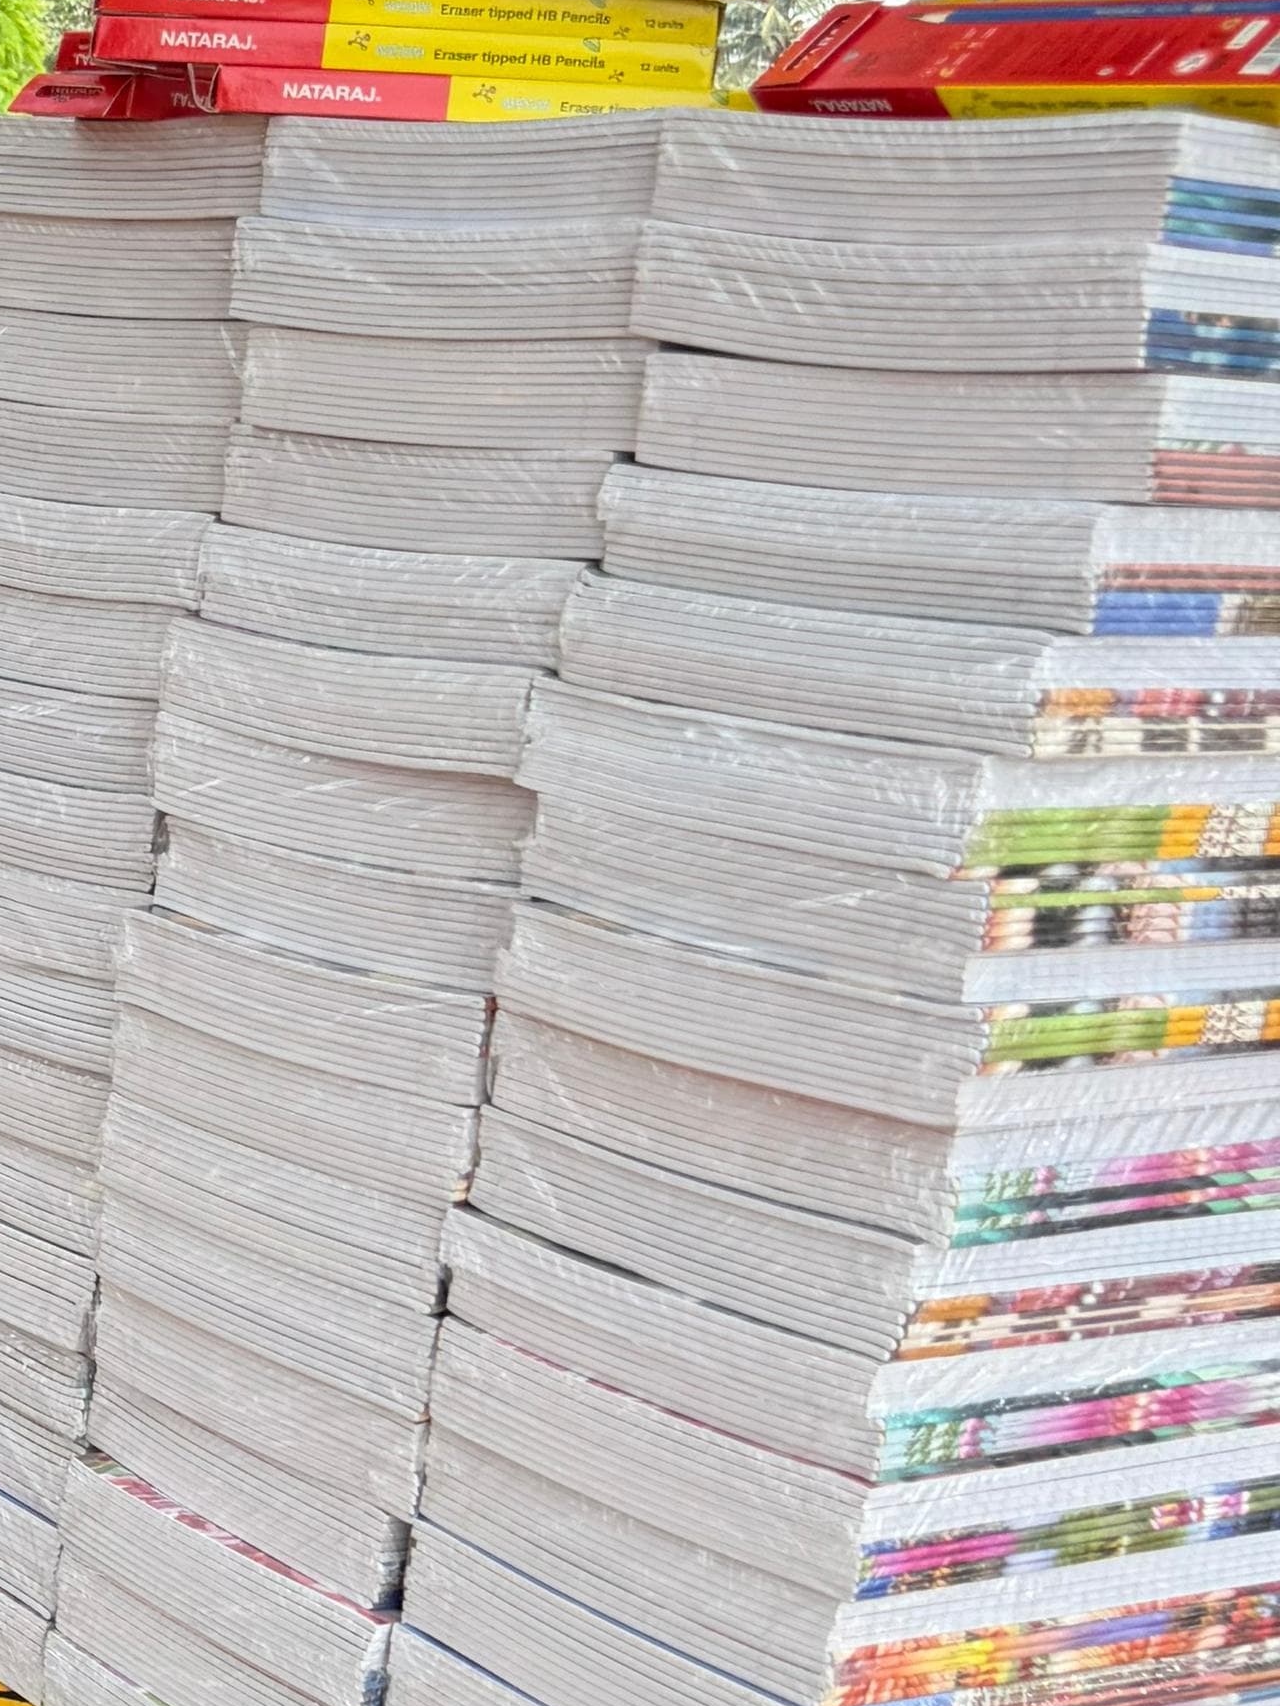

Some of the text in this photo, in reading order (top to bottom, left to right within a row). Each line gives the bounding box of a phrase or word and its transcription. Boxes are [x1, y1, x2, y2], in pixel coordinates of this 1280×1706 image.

[440, 3, 485, 17] Eraser
[488, 6, 533, 21] tipped
[537, 10, 557, 21] HB
[561, 11, 611, 25] Pencils
[434, 49, 478, 61] Eraser
[481, 51, 527, 65] tipped
[531, 54, 551, 66] HB
[555, 55, 605, 69] Pencils
